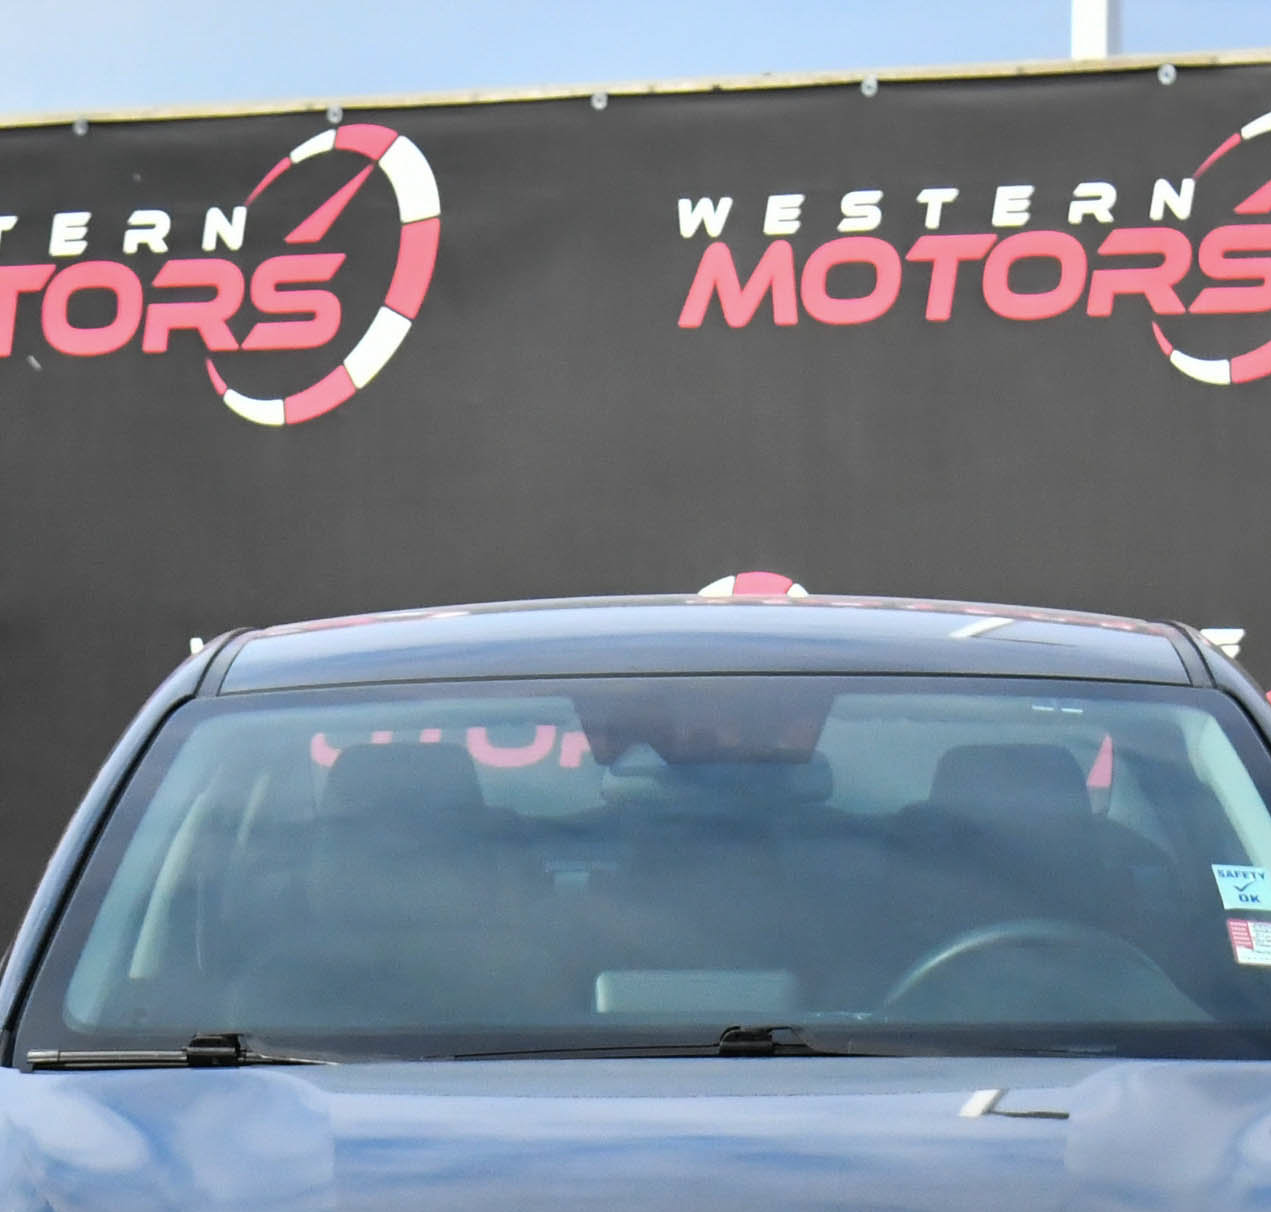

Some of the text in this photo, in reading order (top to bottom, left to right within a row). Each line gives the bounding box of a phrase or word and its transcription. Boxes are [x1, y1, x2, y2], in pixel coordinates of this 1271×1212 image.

[677, 178, 1195, 239] WESTERN
[1217, 868, 1266, 880] SAFETY
[1238, 893, 1261, 904] OK
